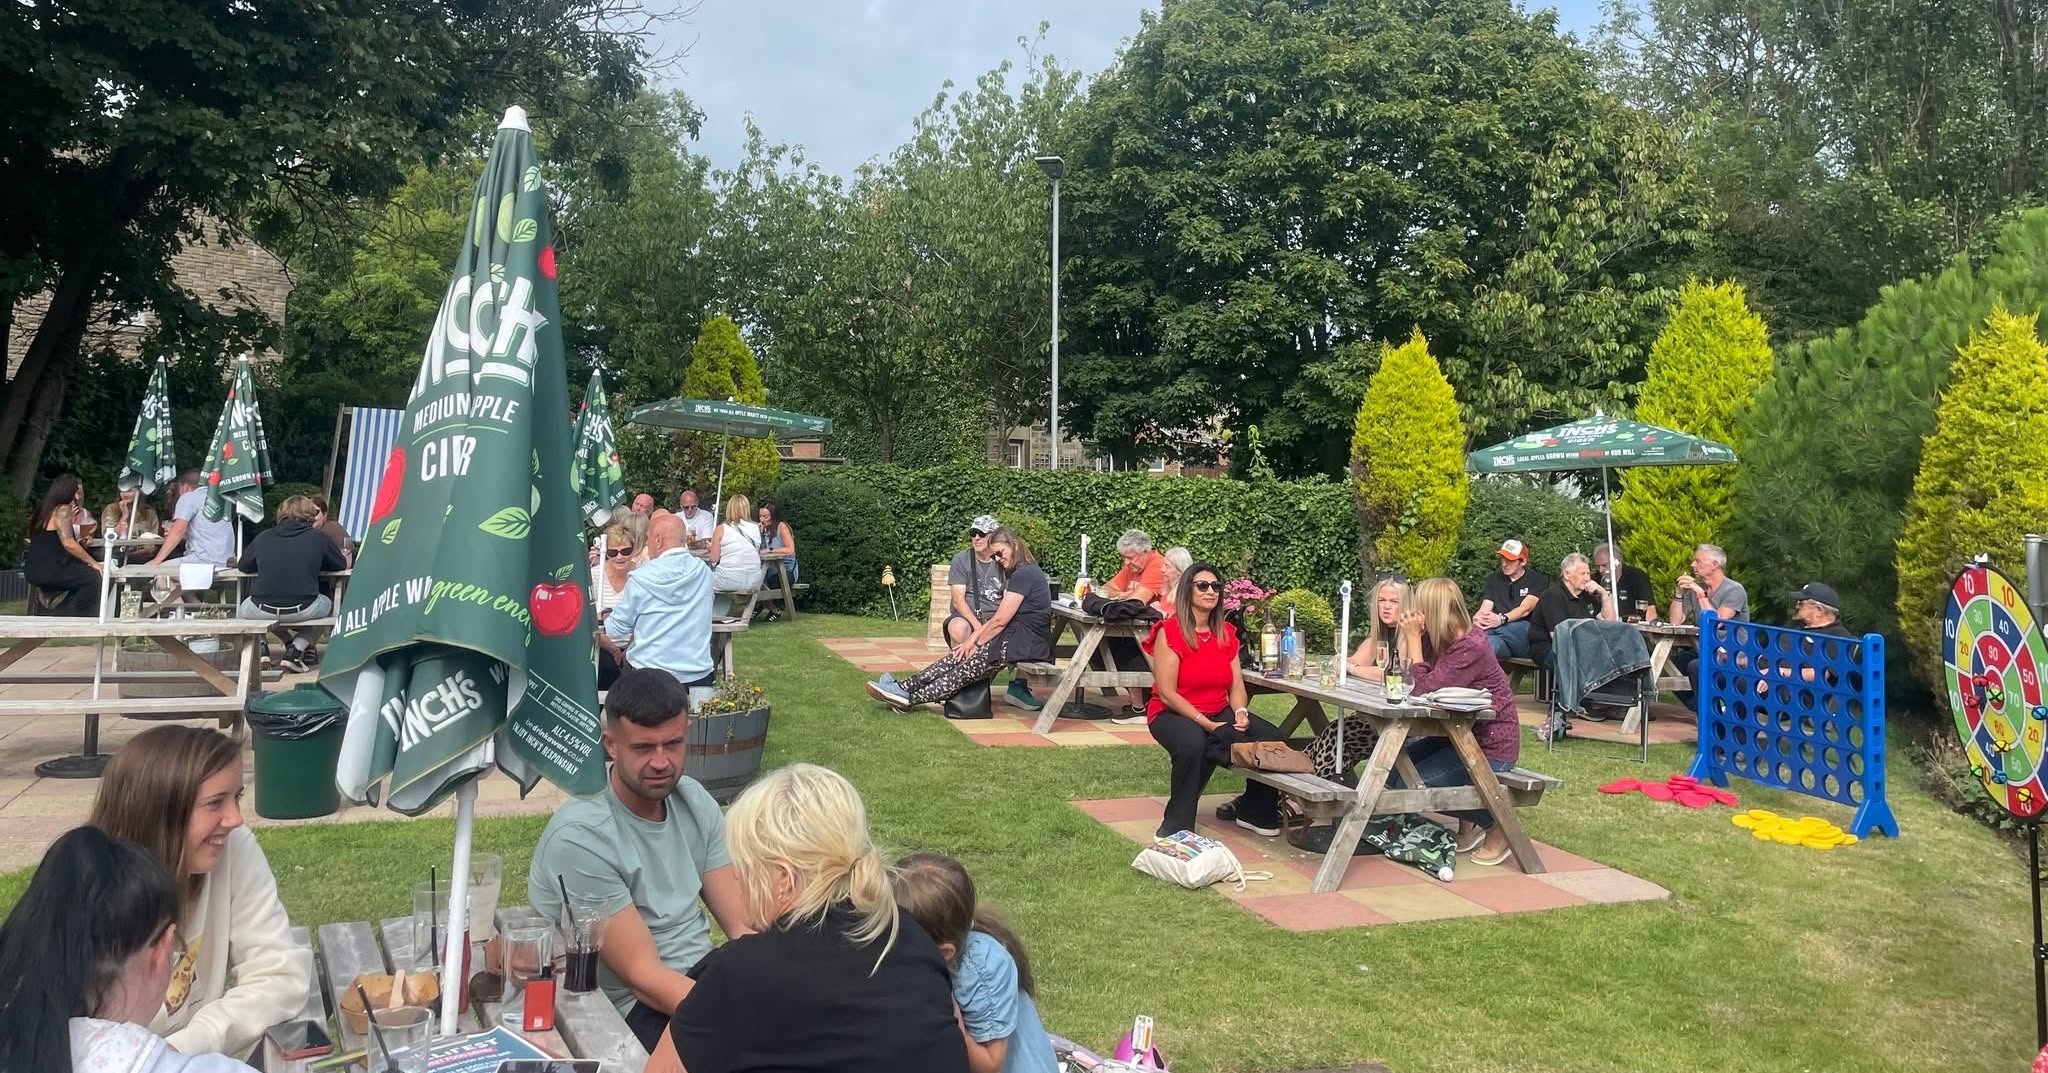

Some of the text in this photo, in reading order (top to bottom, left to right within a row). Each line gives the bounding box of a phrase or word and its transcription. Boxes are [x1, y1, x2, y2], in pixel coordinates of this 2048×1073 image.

[470, 396, 519, 424] PPLE
[1963, 572, 1975, 594] 10
[345, 607, 368, 632] ALL
[371, 583, 400, 623] APPLE
[424, 580, 493, 615] green
[2001, 585, 2015, 608] 10
[1945, 618, 1955, 639] 10
[1973, 609, 2009, 635] 30 40
[1960, 640, 1999, 661] 20 90
[2022, 669, 2034, 685] 50
[1949, 690, 2020, 712] 70 10
[525, 718, 585, 764] bedrinkaware.co.uk
[551, 724, 566, 738] ALC
[2028, 726, 2039, 743] 20
[512, 721, 579, 775] ENJOY INCH'S RESPONSIBLY
[2011, 757, 2022, 773] 50
